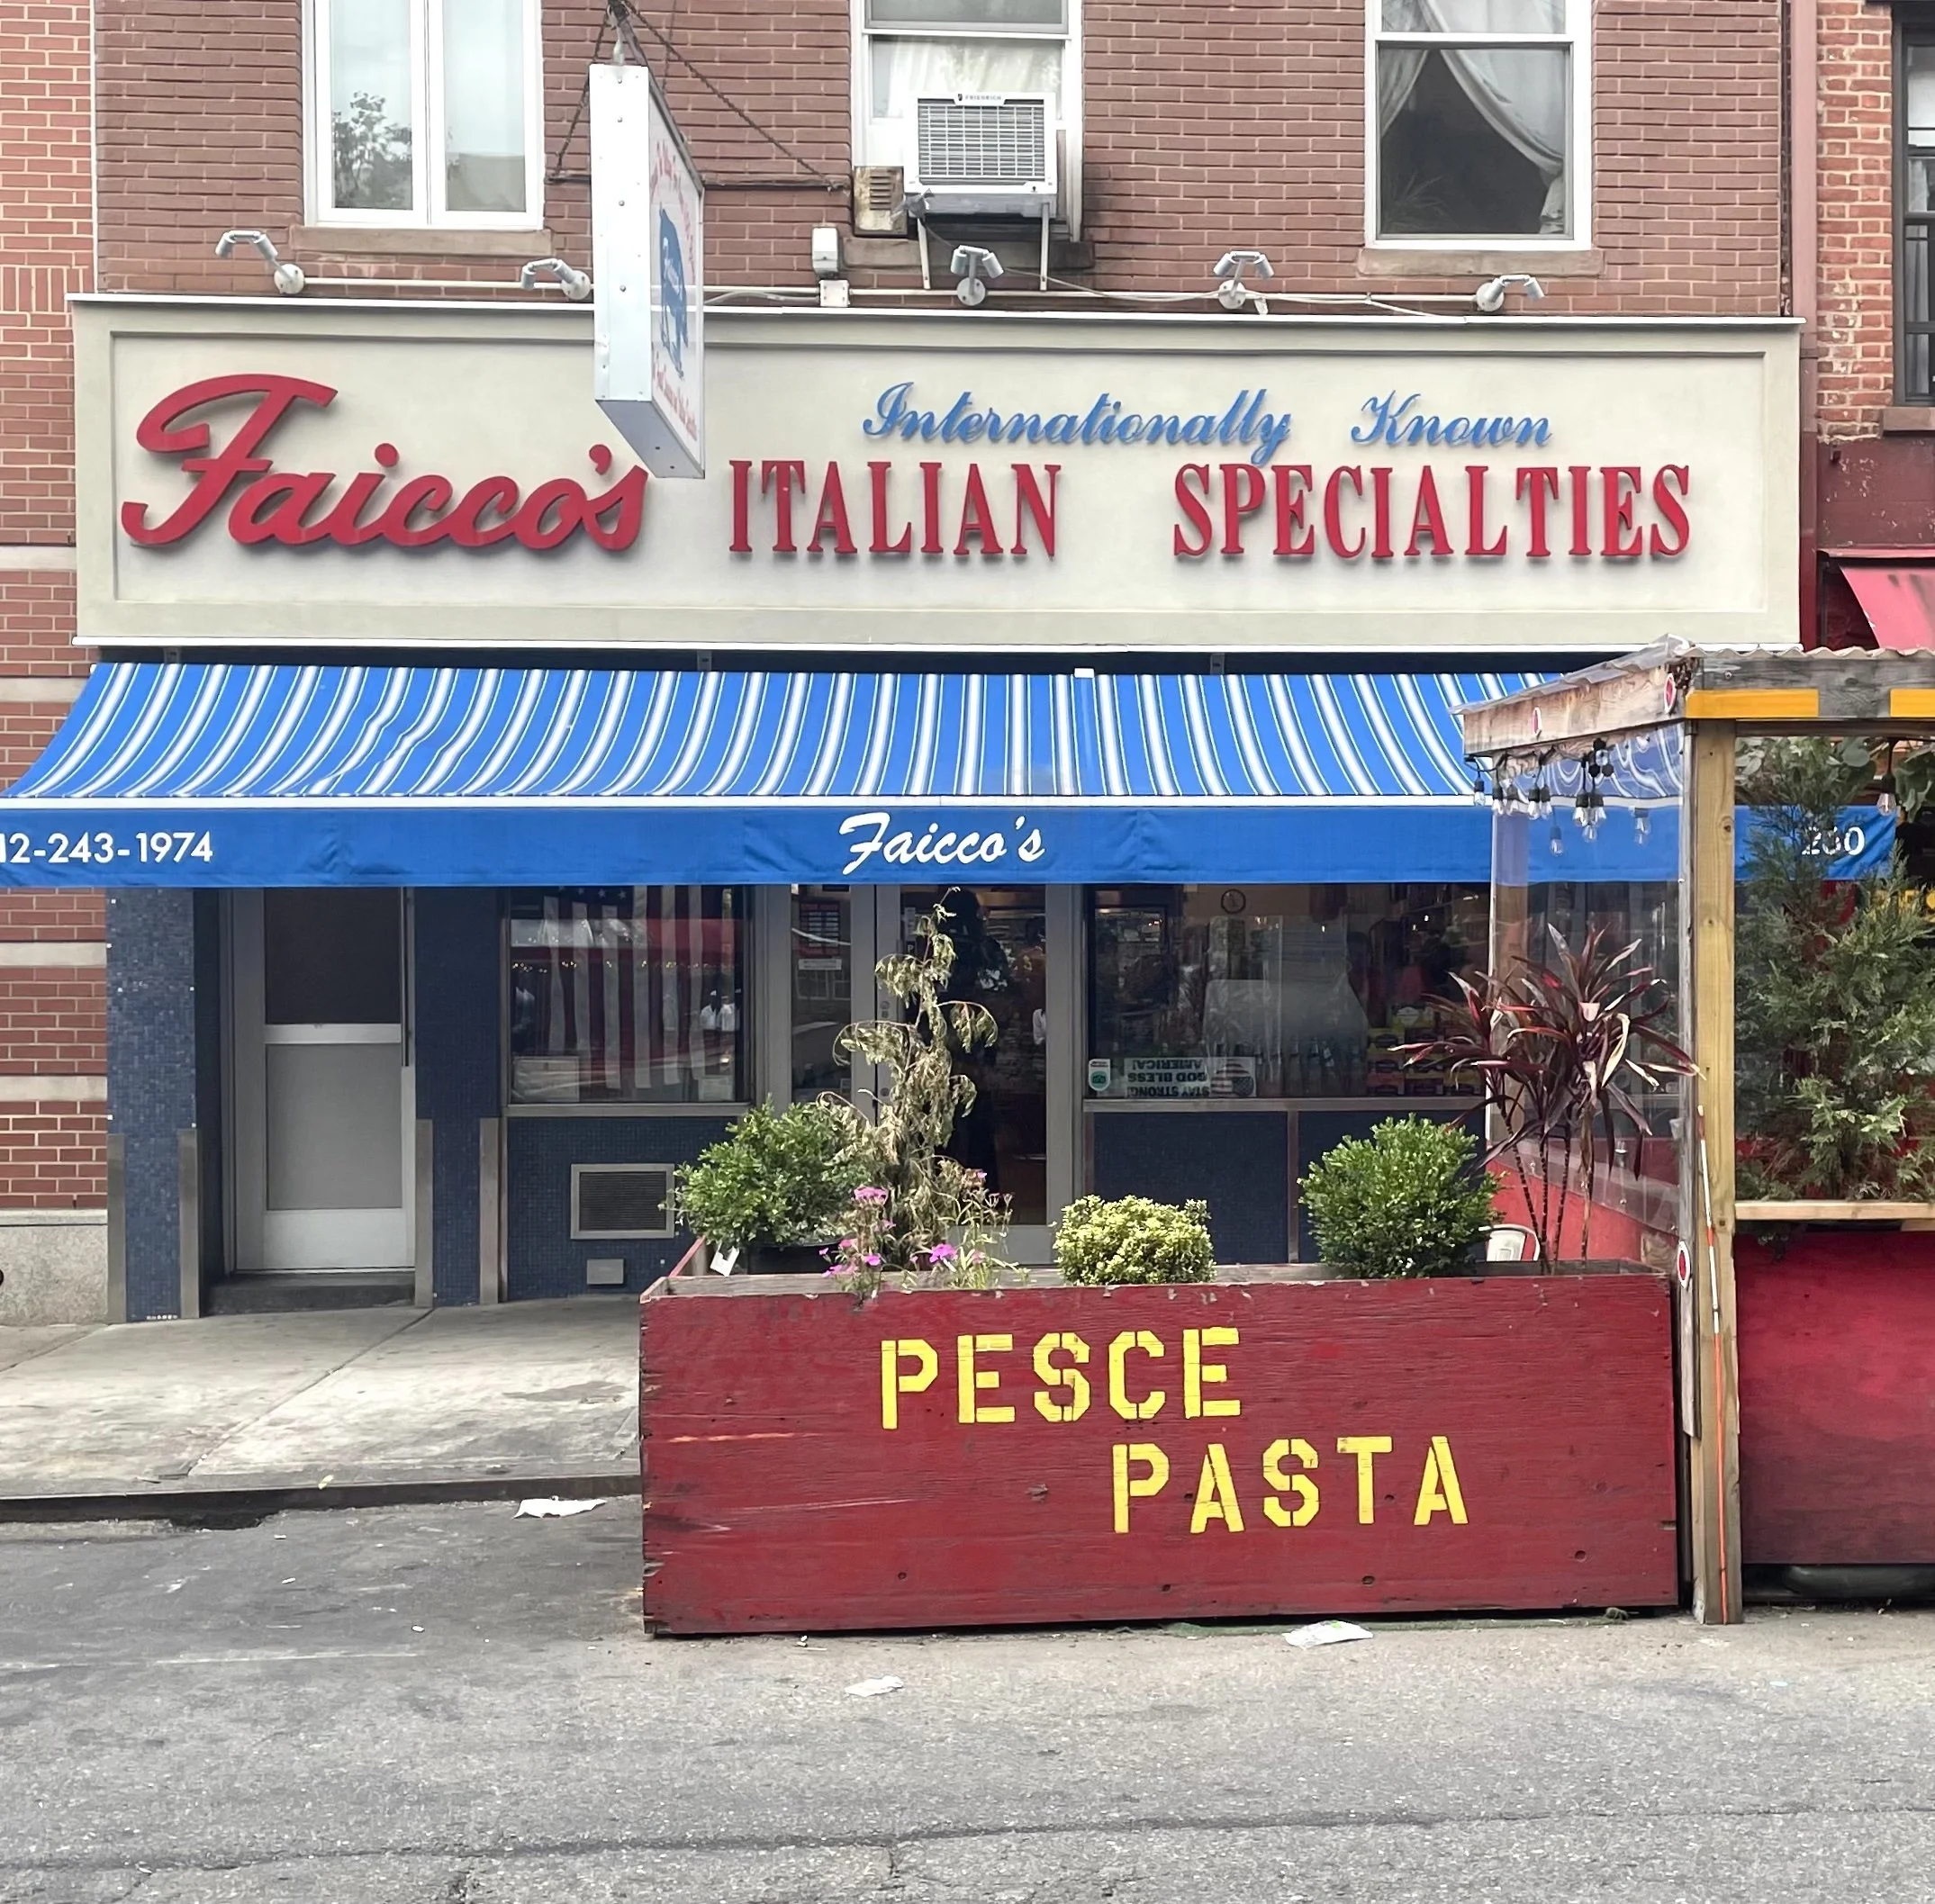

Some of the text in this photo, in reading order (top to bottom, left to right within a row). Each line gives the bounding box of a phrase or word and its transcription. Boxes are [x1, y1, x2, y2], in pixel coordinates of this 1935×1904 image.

[121, 374, 649, 551] Faicco's
[863, 381, 1551, 465] Internationally Known
[728, 460, 1690, 560] ITALIAN SPECIALTIES
[838, 812, 1046, 876] Faicco's
[1127, 1071, 1207, 1083] GOD BLESS
[1132, 1059, 1204, 1070] AMERICA!
[1180, 1086, 1210, 1097] STAY
[882, 1327, 1241, 1430] PESCE
[1112, 1436, 1469, 1534] PASTA
